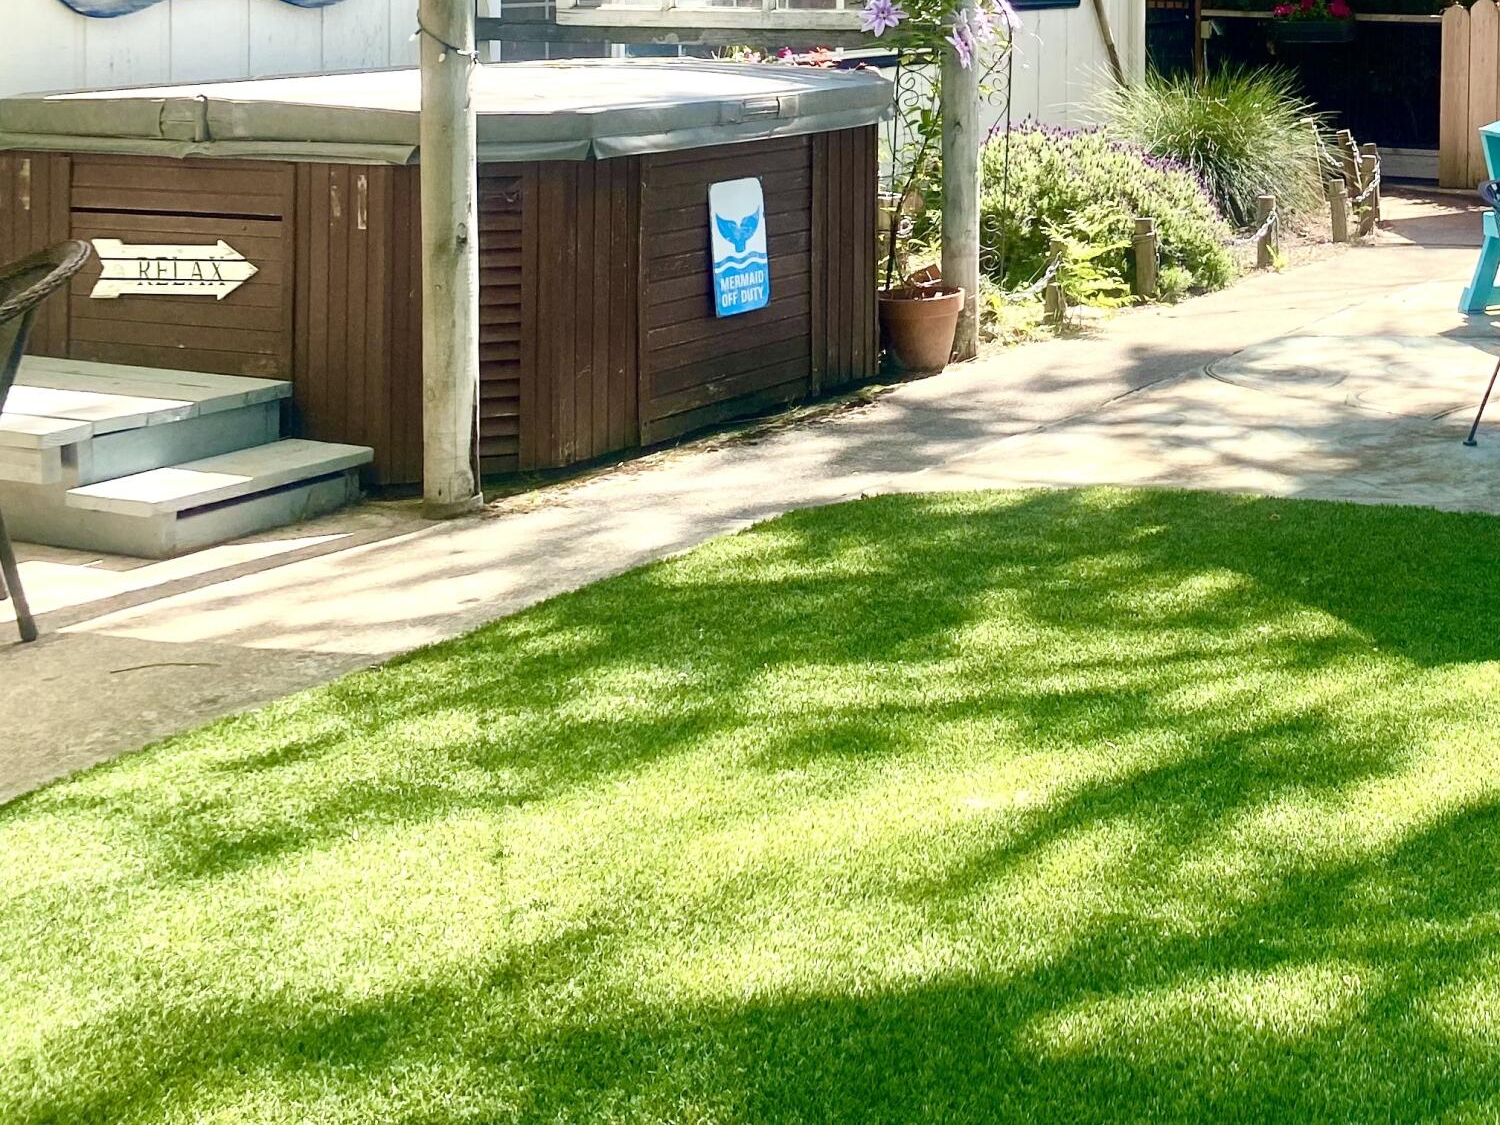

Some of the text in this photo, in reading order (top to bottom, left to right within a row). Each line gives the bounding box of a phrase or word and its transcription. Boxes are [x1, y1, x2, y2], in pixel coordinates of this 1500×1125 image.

[137, 256, 226, 286] RELAX
[720, 270, 764, 292] MERMAID
[721, 286, 764, 308] OFF DUTY
